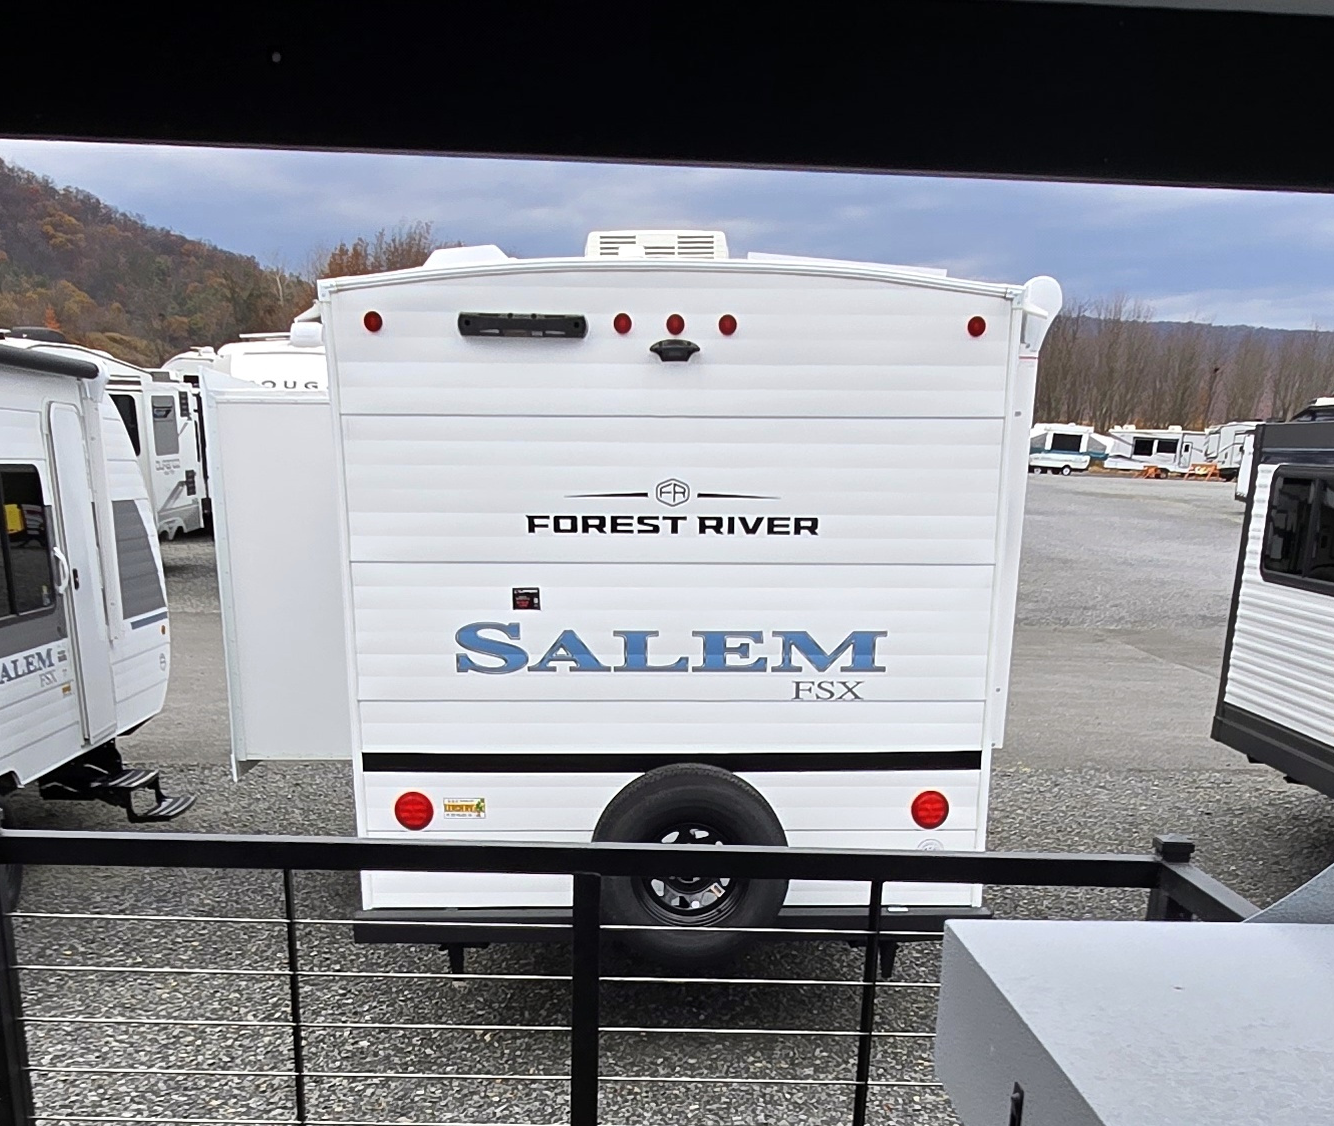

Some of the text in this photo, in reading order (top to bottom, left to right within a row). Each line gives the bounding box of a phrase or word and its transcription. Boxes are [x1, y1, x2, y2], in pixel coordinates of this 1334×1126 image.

[525, 514, 820, 536] FOREST RIVER
[454, 621, 889, 675] SALEM
[791, 680, 866, 701] FSX
